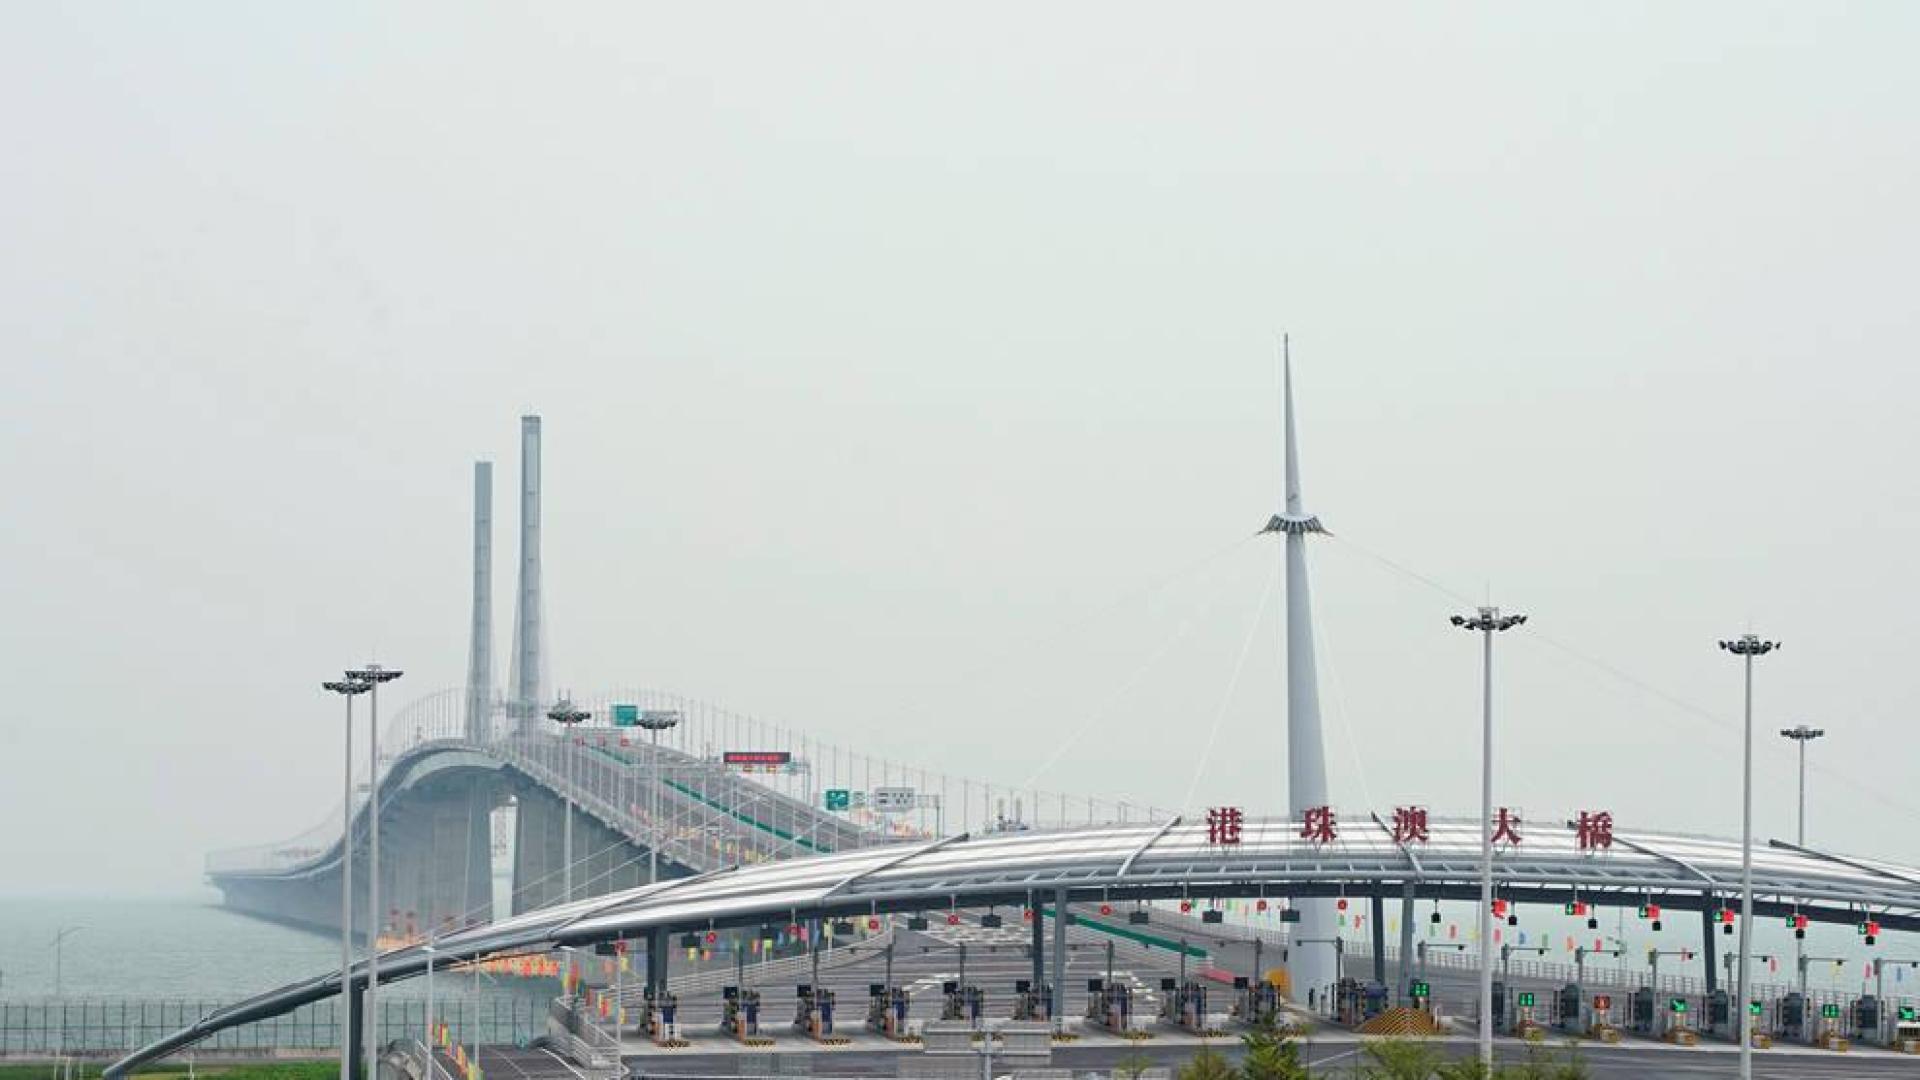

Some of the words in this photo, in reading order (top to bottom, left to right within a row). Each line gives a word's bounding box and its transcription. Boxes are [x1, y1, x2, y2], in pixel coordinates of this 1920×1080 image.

[1207, 806, 1613, 848] 港珠澳大橋
